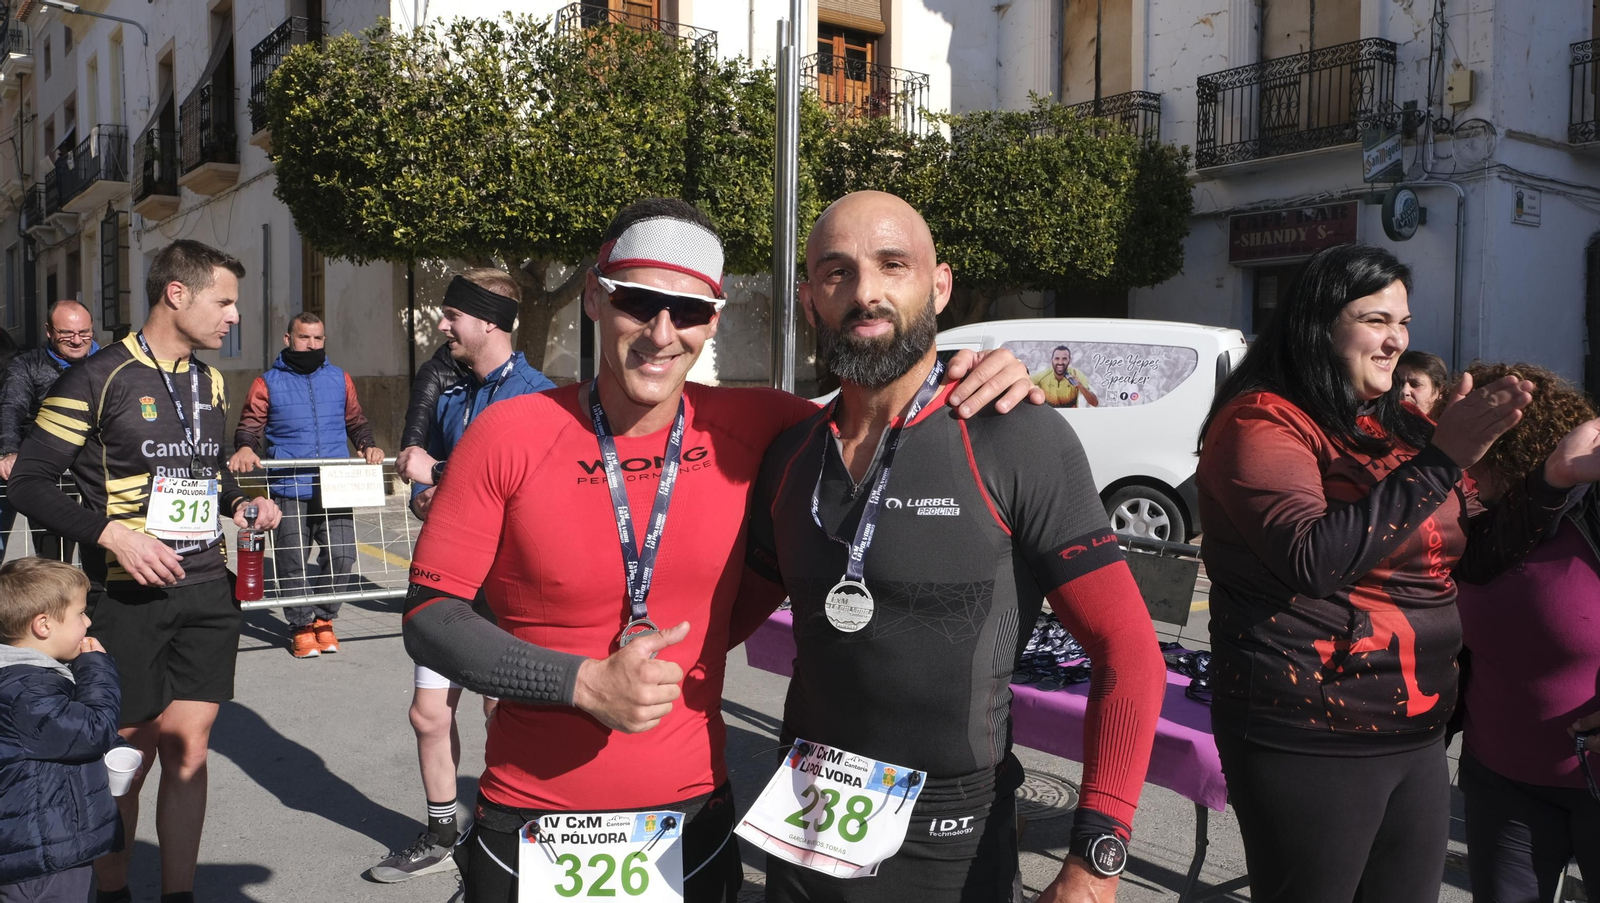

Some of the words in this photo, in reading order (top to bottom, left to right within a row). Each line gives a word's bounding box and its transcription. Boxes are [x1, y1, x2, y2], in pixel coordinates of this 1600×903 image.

[1092, 353, 1123, 372] Pepe
[1126, 354, 1160, 373] Yepes
[1101, 371, 1150, 389] Speaker
[156, 466, 212, 478] Runrs
[577, 460, 711, 485] PEORMNCE
[168, 499, 210, 523] 313
[906, 498, 959, 507] LURBEL
[412, 566, 441, 582] ONG
[816, 746, 843, 765] CxM
[809, 762, 862, 788] PÓLVORA
[544, 816, 561, 828] IV
[565, 816, 602, 828] CxM
[784, 784, 873, 843] 238
[539, 833, 556, 844] LA
[561, 830, 627, 844] PÓLVORA
[929, 826, 974, 837] Technology
[554, 851, 650, 897] 326
